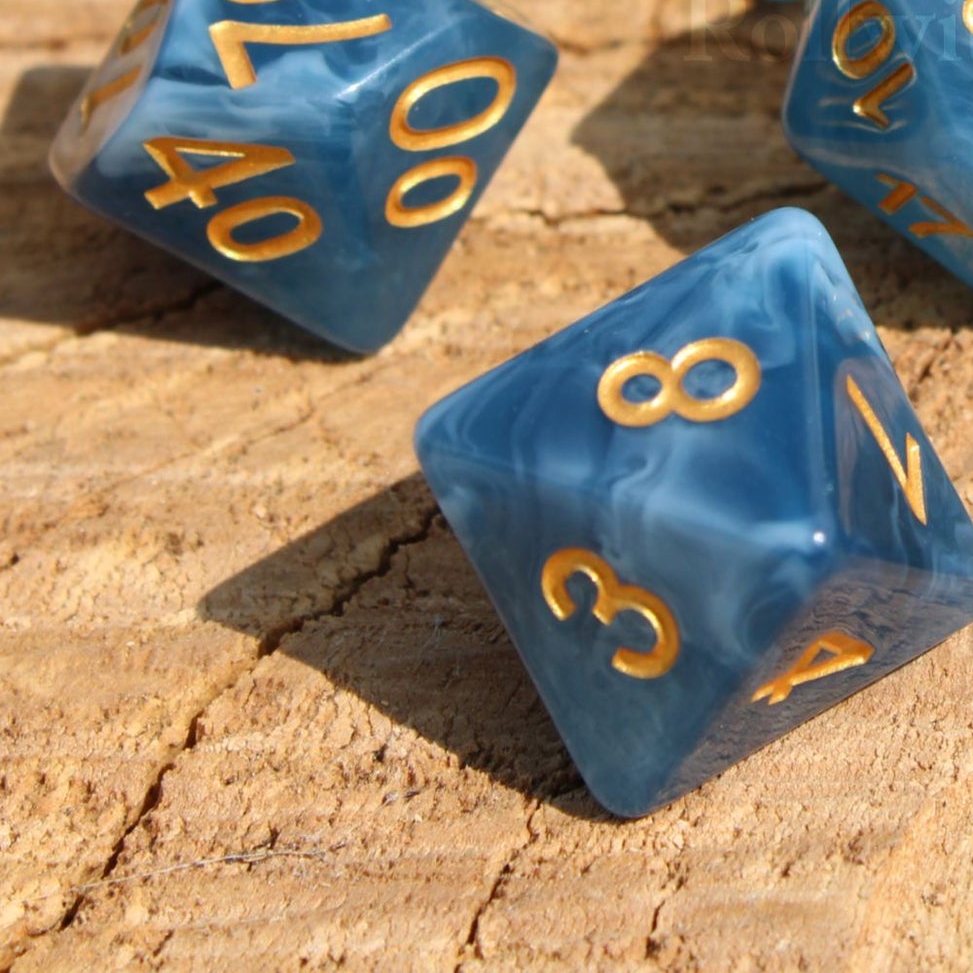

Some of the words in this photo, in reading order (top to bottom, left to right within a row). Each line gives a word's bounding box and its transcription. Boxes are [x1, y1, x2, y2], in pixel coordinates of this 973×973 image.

[830, 0, 917, 128] 10
[142, 135, 323, 263] 40
[385, 54, 518, 229] 00
[596, 336, 762, 428] 8
[539, 546, 681, 680] 3
[749, 630, 876, 706] 4
